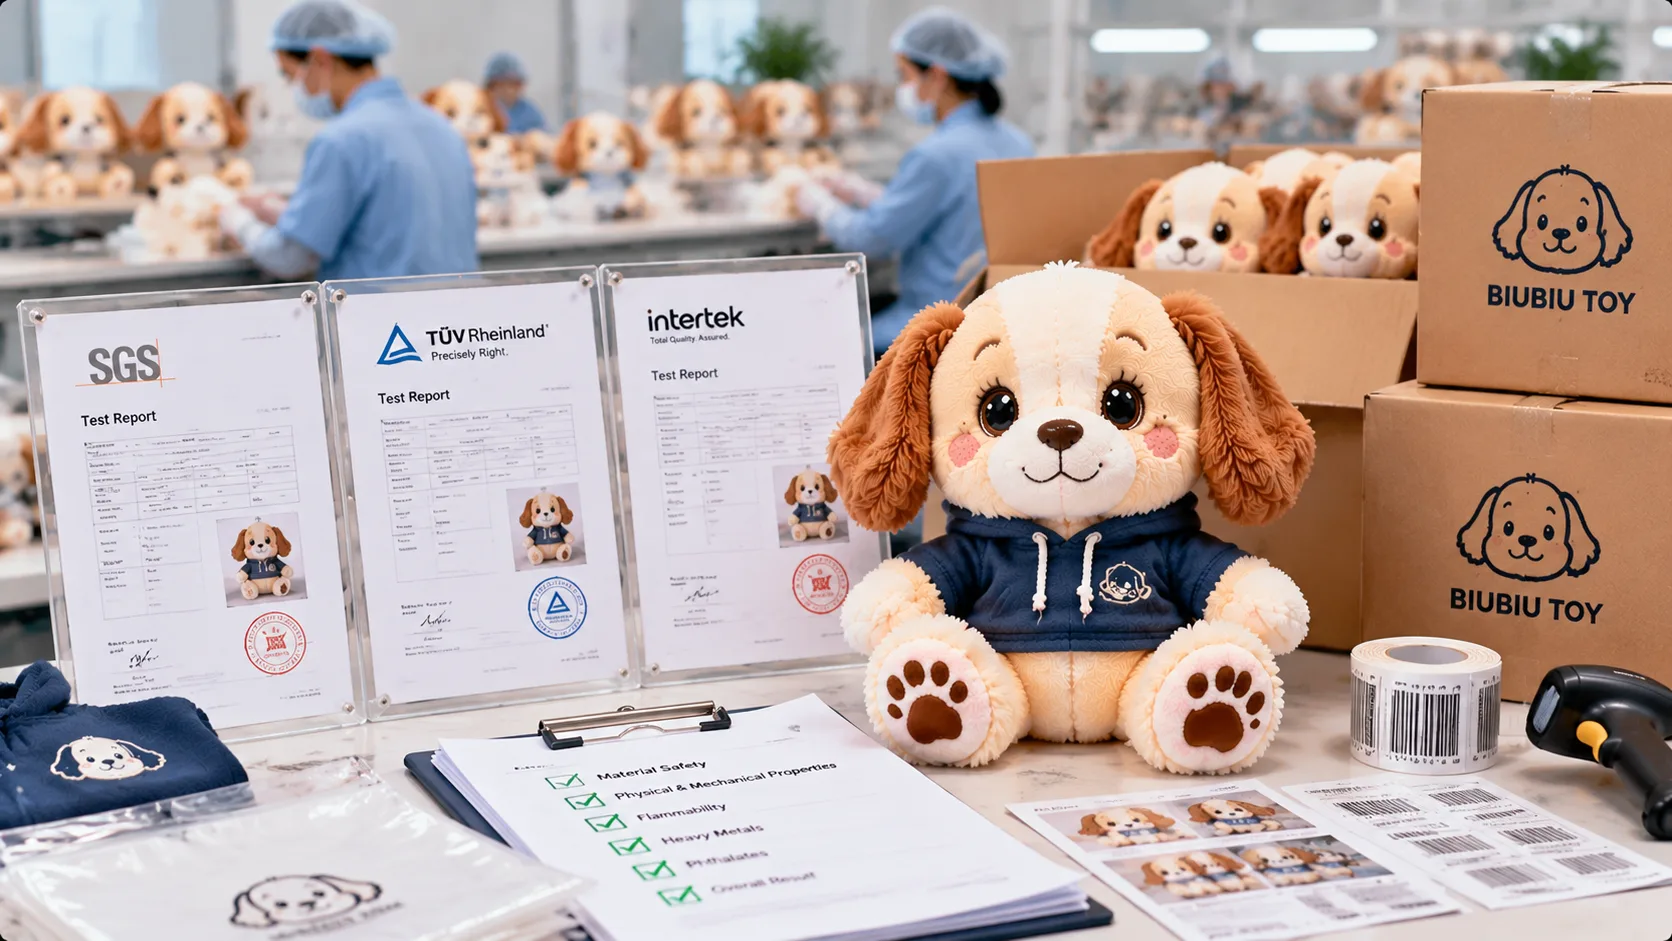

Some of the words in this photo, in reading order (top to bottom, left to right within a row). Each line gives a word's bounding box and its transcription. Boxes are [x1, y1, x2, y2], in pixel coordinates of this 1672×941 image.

[1487, 284, 1575, 311] BIUBIU
[1582, 289, 1636, 315] TOY
[647, 305, 745, 332] intertek
[426, 326, 466, 346] TÜV
[468, 323, 546, 343] Rheinland
[650, 336, 668, 345] Total
[88, 344, 161, 386] SGS
[431, 349, 476, 361] Precisely
[479, 347, 509, 360] Right.
[651, 370, 677, 381] Test
[679, 368, 719, 381] Report
[378, 392, 405, 405] Test
[409, 389, 450, 404] Report
[81, 414, 110, 427] Test
[113, 410, 157, 426] Report
[1450, 587, 1541, 618] BIUBIU
[1548, 598, 1604, 624] TOY
[597, 766, 658, 781] Material
[660, 759, 707, 773] Safety
[615, 784, 674, 801] Physical
[676, 784, 688, 792] &
[689, 772, 766, 790] Mechanical
[768, 761, 837, 779] Properties
[662, 830, 710, 846] Heavy
[713, 823, 764, 838] Metals
